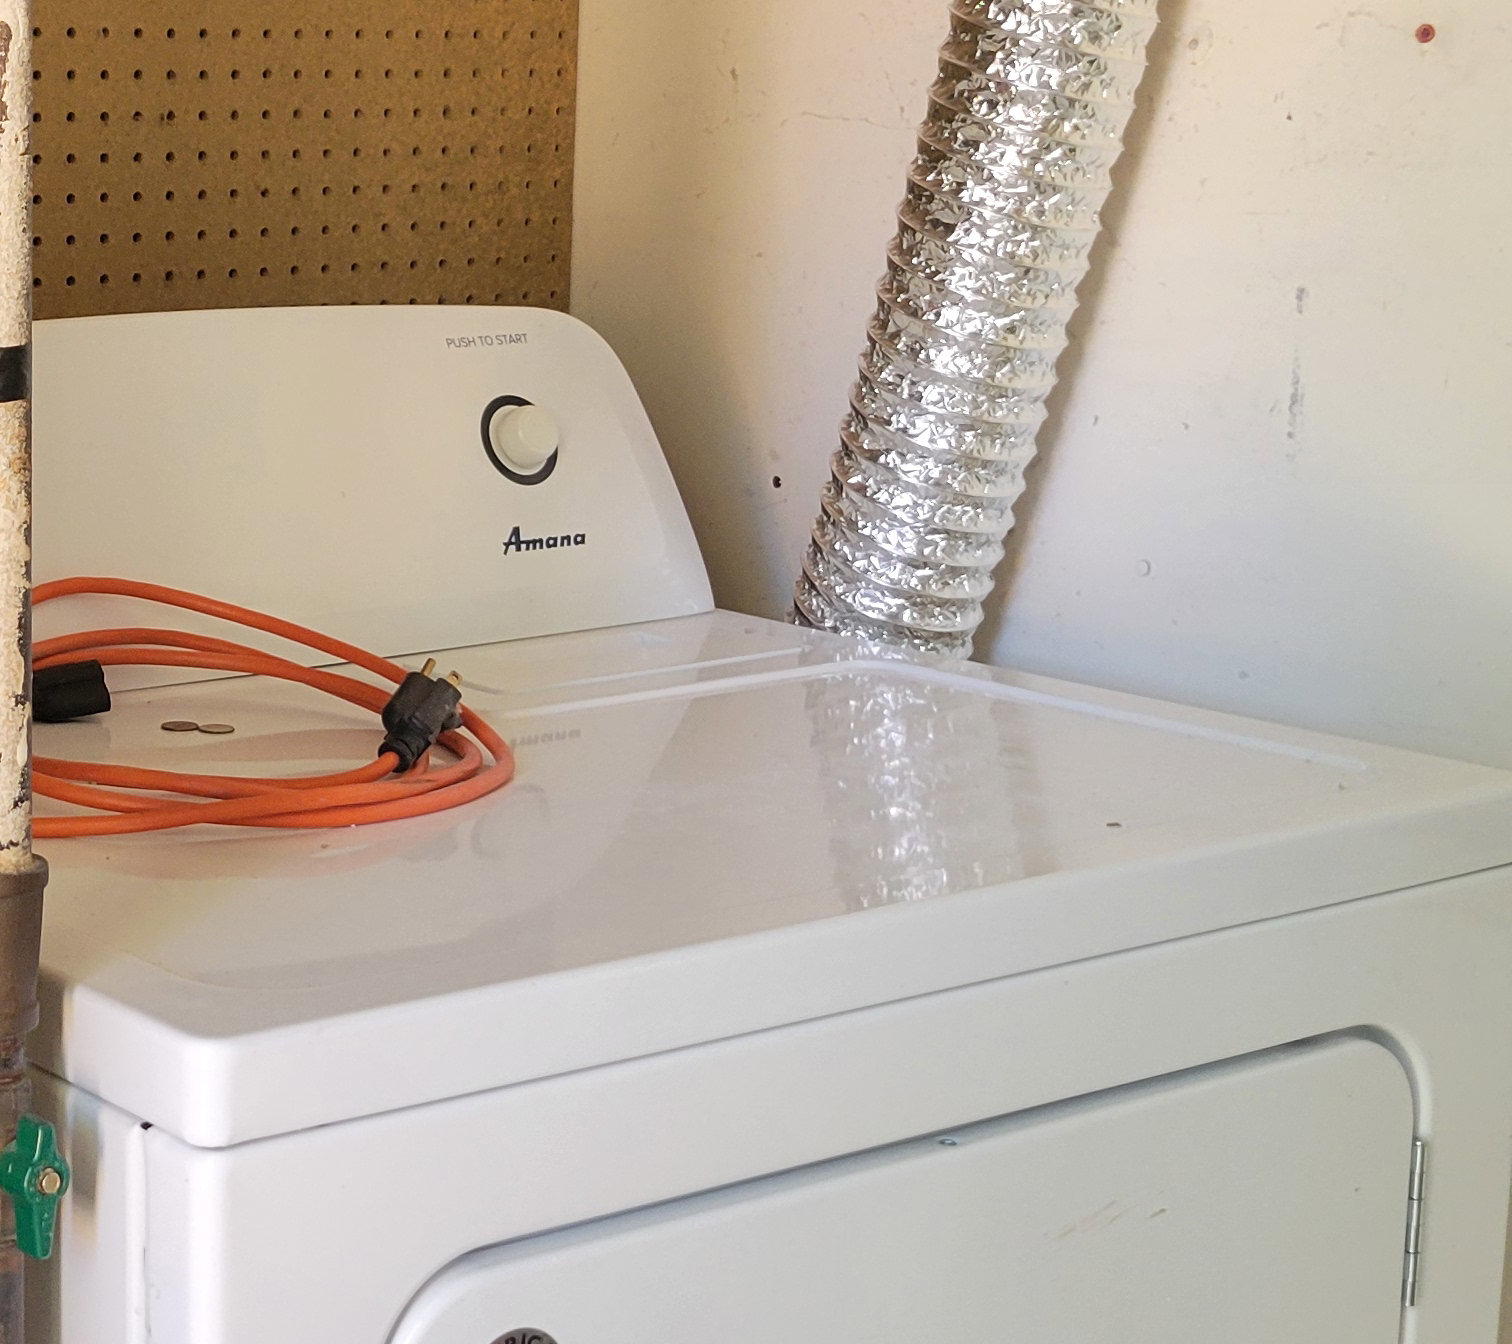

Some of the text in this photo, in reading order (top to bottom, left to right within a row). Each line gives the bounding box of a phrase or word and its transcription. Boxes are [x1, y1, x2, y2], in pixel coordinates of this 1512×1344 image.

[445, 333, 528, 349] PUSH TO START
[502, 526, 586, 556] Amana
